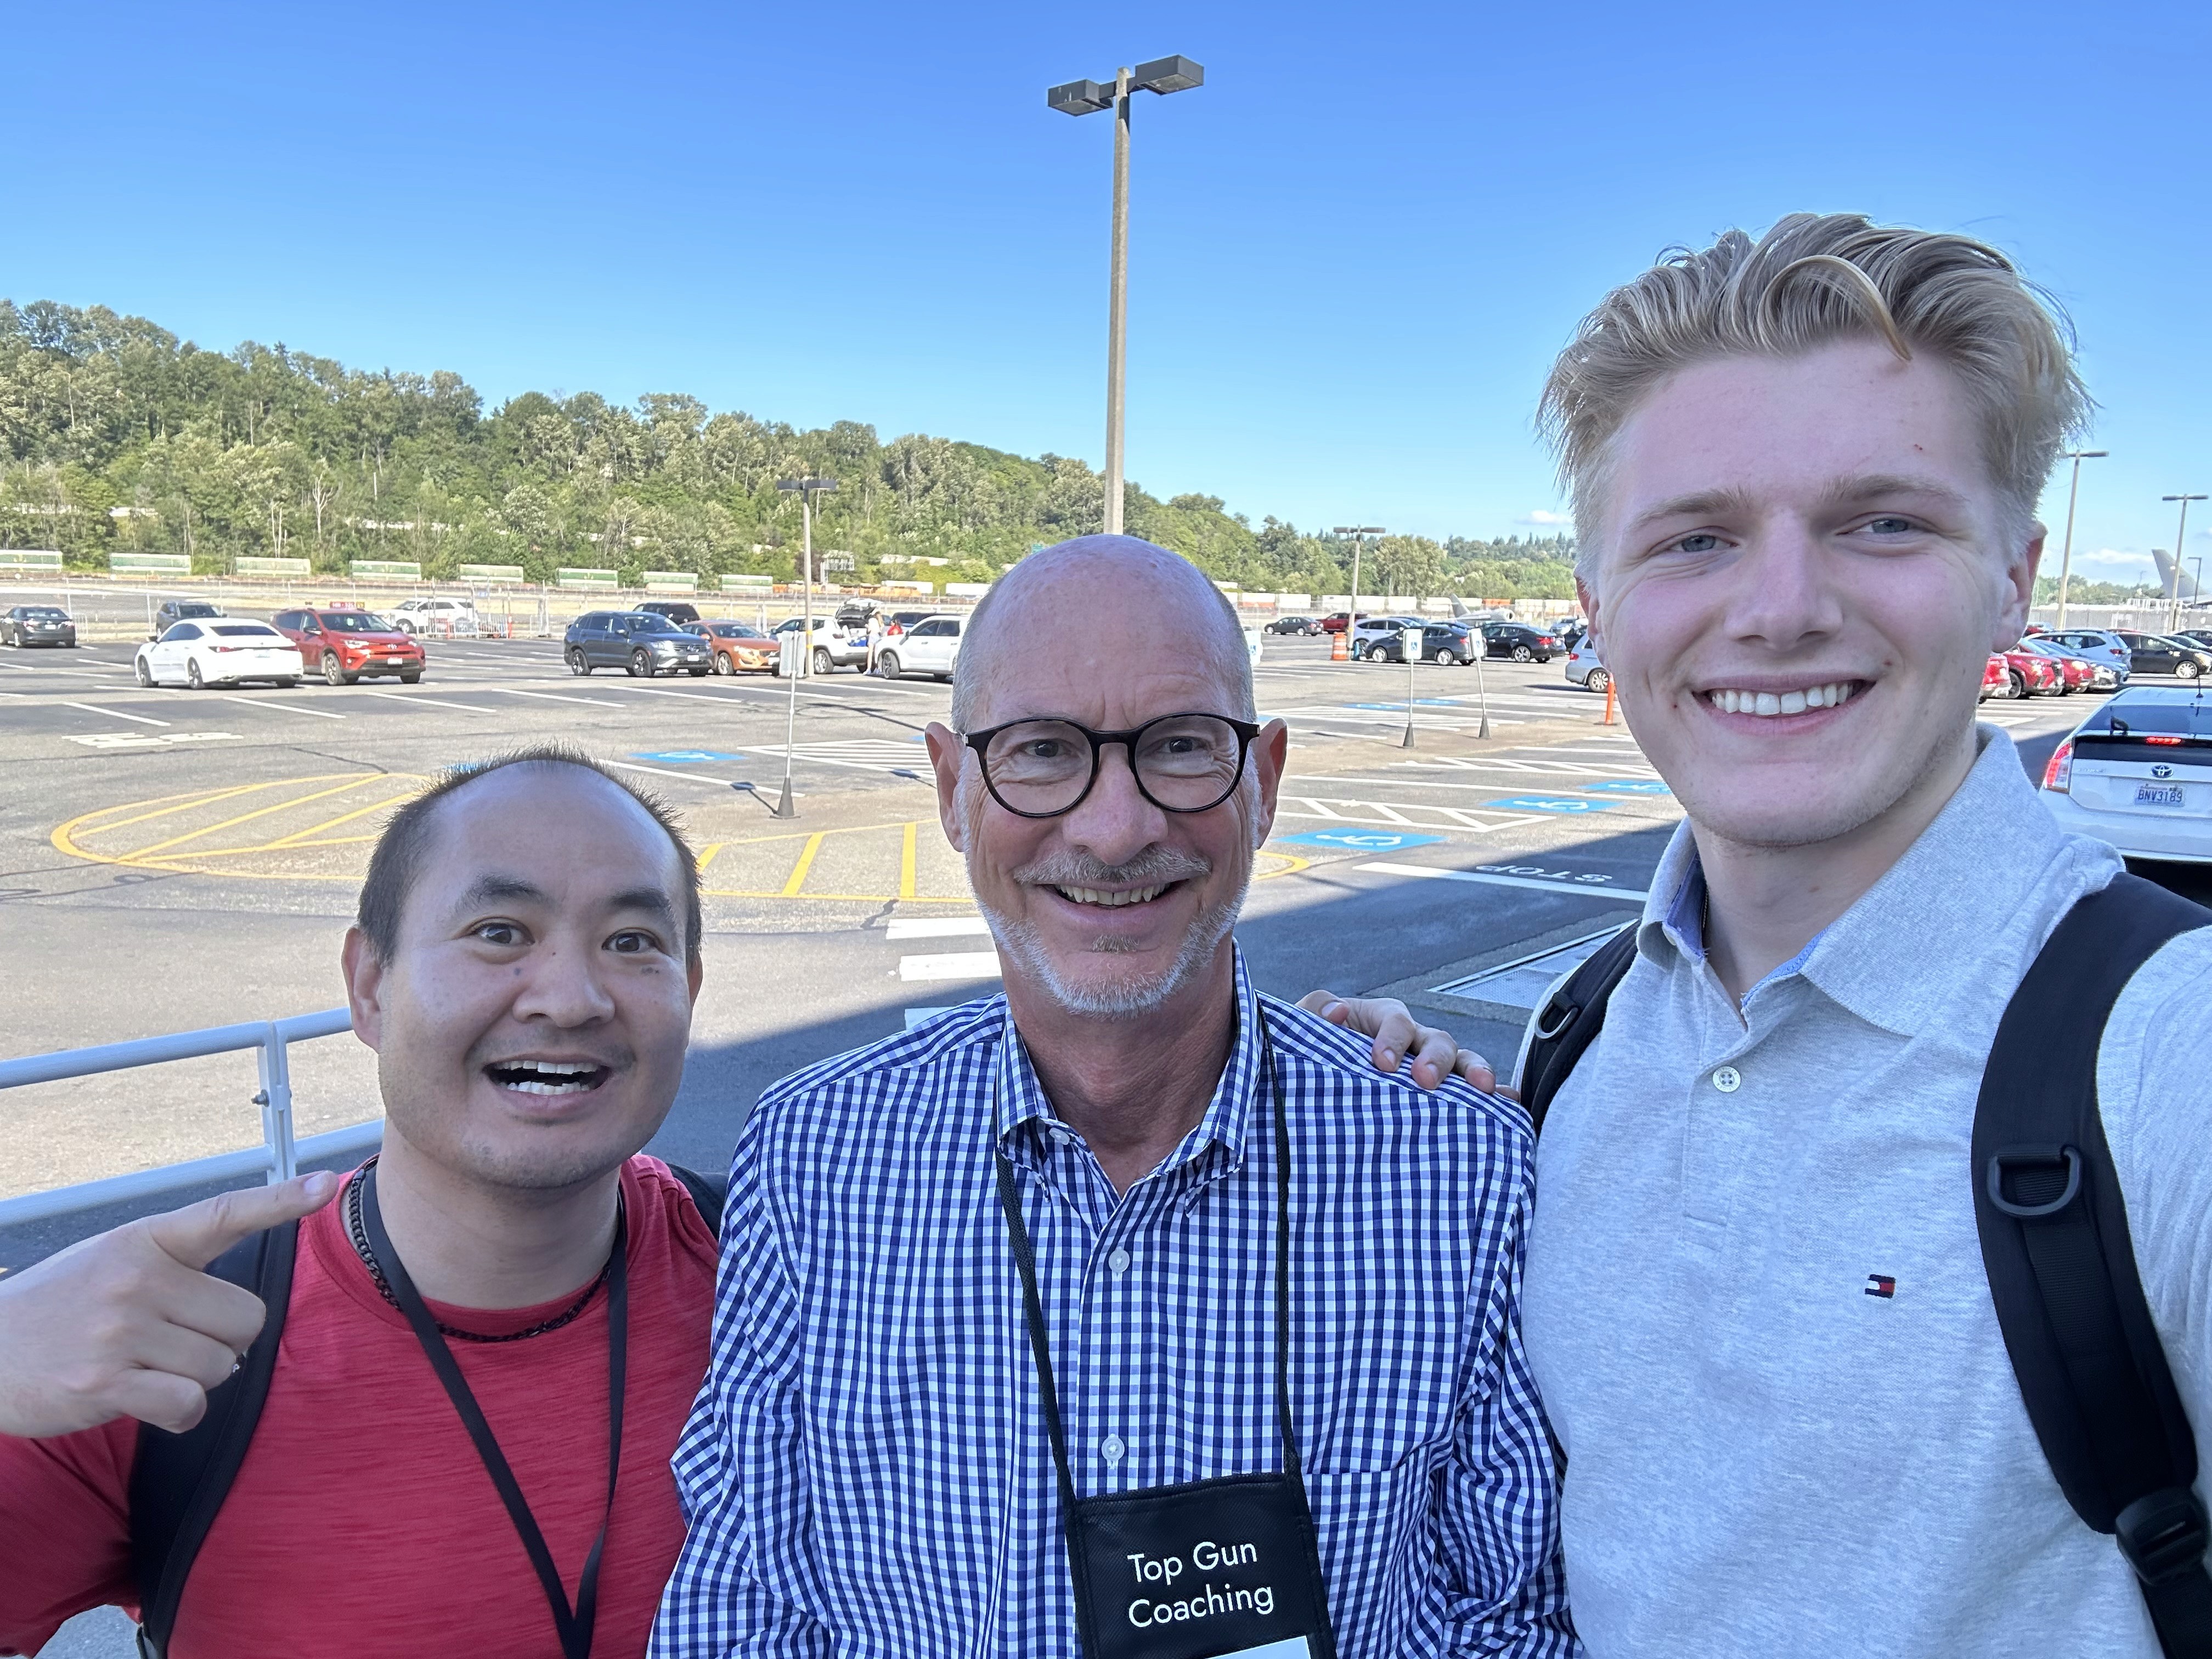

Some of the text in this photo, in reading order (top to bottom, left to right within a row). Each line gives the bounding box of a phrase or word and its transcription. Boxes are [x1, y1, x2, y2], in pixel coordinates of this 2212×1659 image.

[1476, 865, 1612, 883] STOP
[1127, 1541, 1258, 1585] Top Gun
[1128, 1583, 1274, 1628] Coaching
